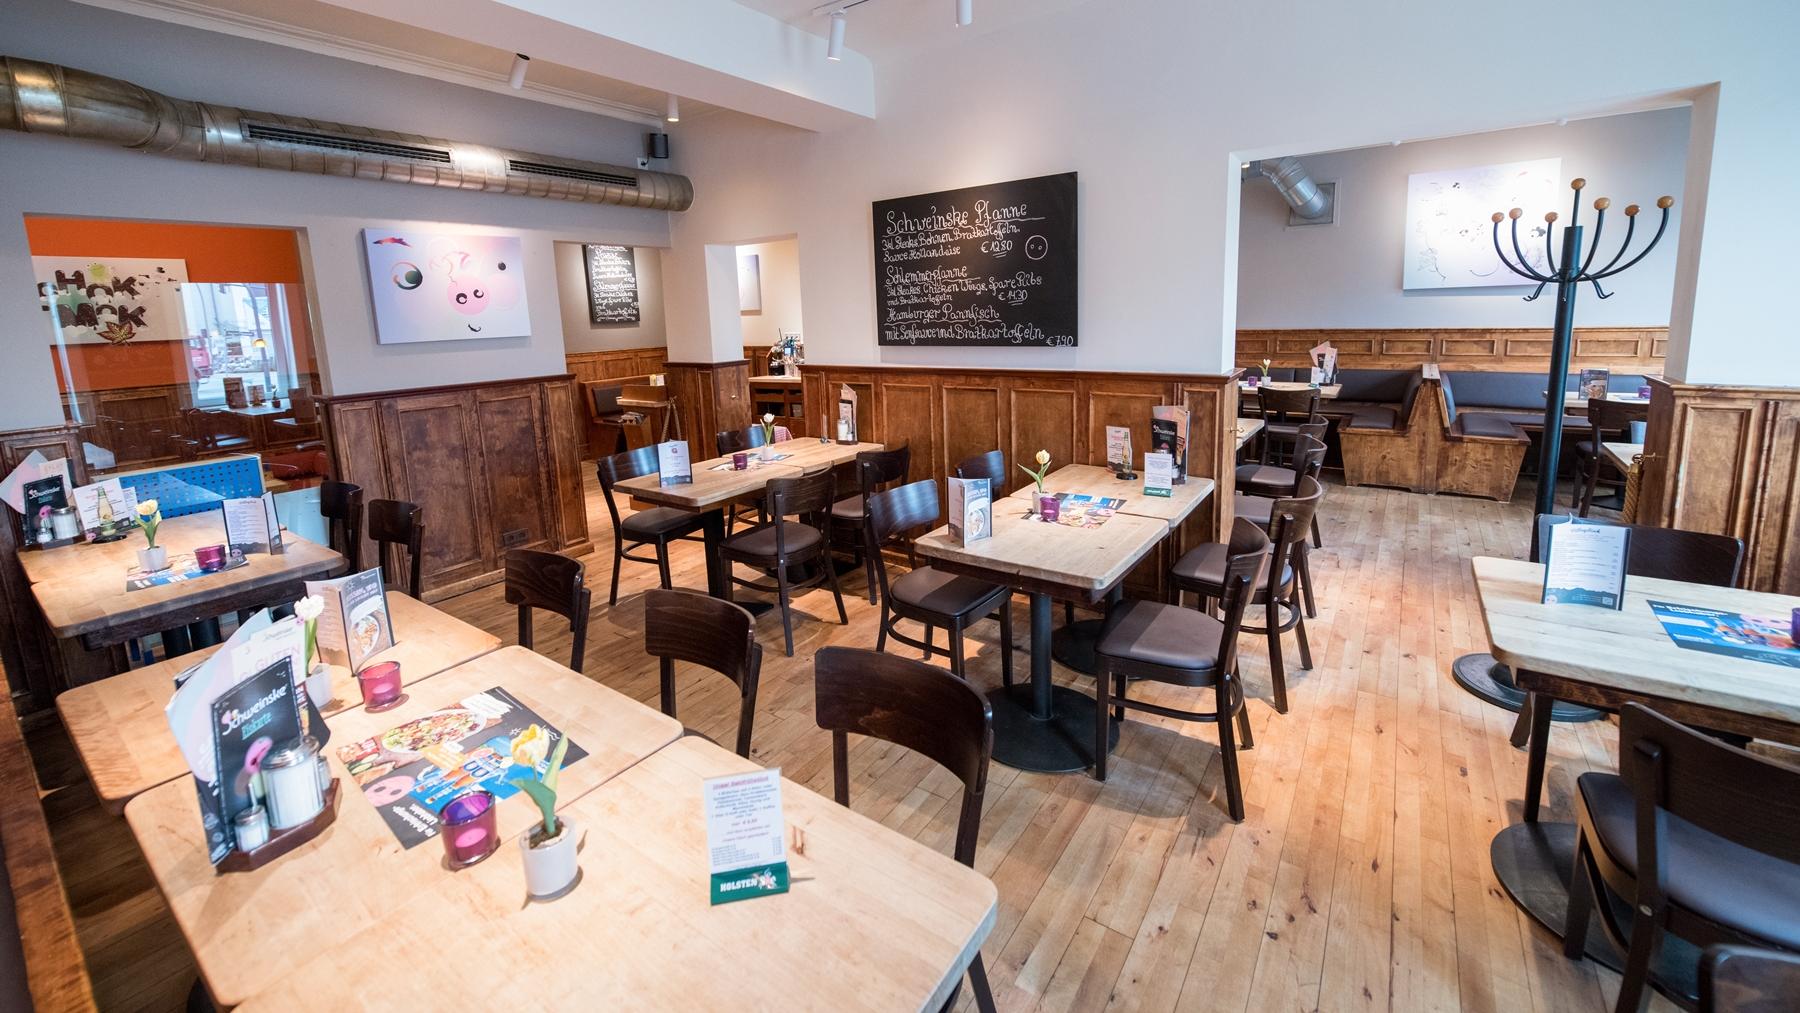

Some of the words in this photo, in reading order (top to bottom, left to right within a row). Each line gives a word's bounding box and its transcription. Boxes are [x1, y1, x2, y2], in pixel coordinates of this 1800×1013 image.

[886, 205, 969, 235] Schweinske
[974, 199, 1027, 228] Pfanne
[1015, 270, 1042, 287] Ribs
[886, 306, 941, 324] Hamburger
[942, 303, 1000, 327] Pannfisch
[954, 322, 1045, 344] Bratkartoffeln
[221, 685, 288, 736] Schweinske
[719, 878, 759, 893] HOLSTEN
